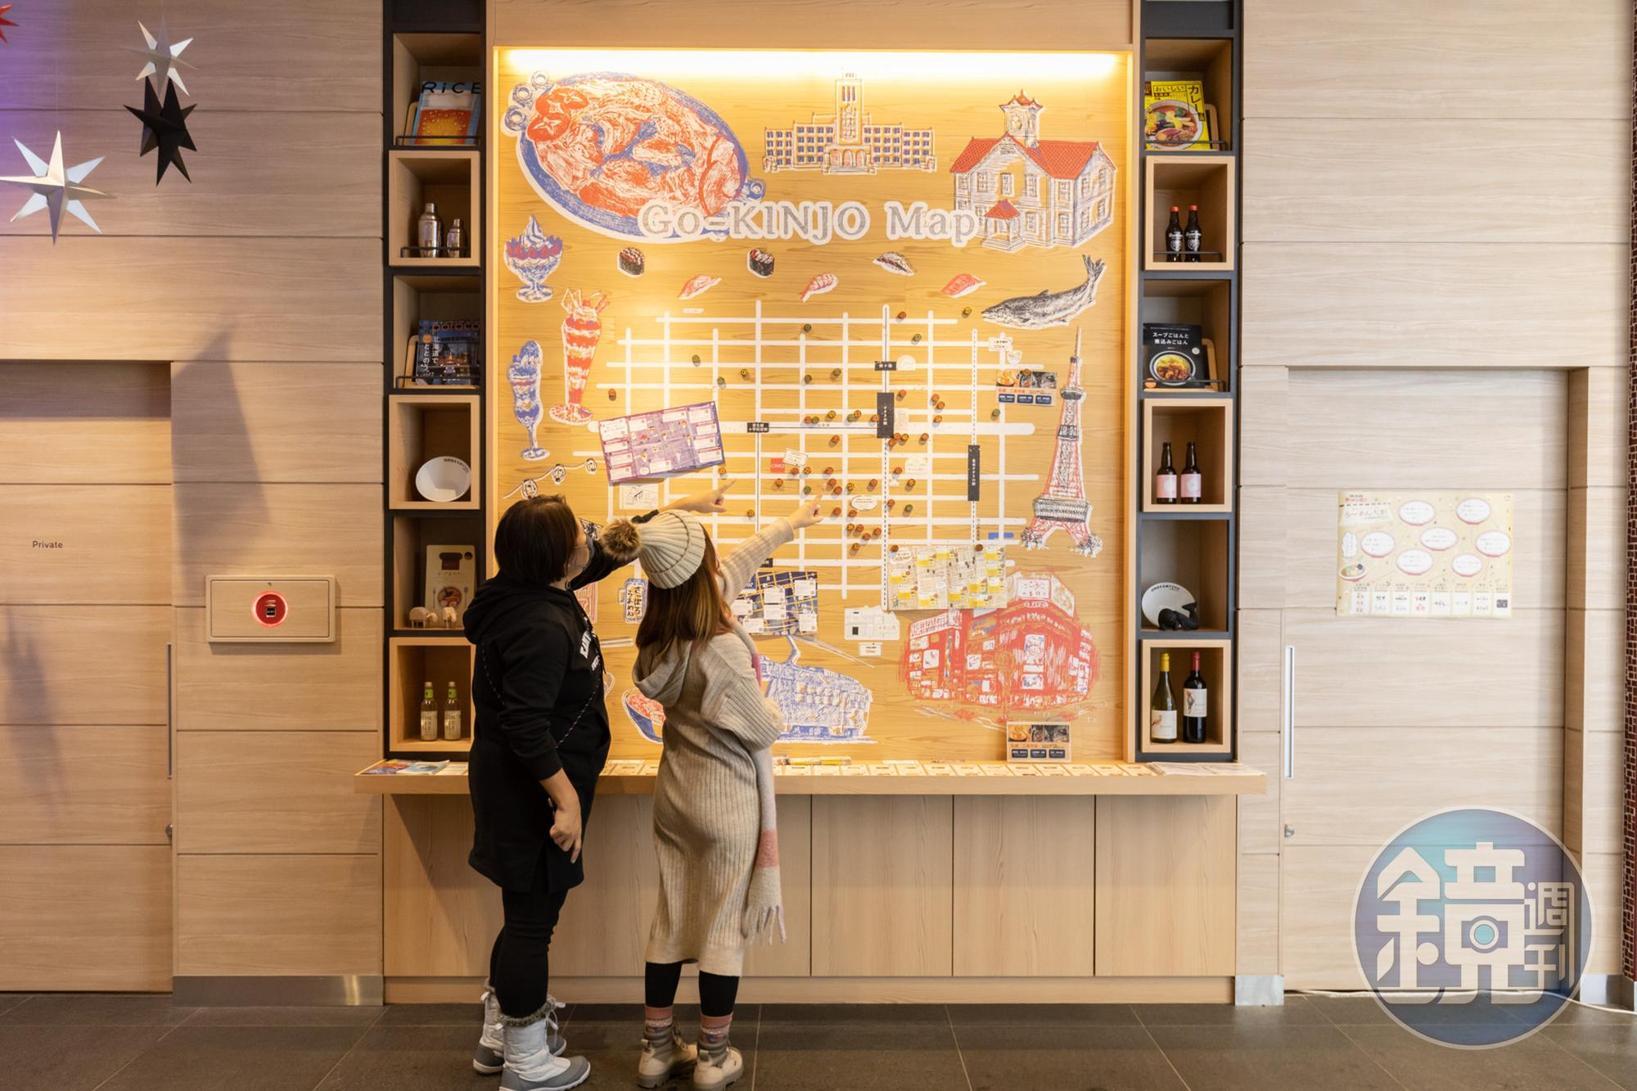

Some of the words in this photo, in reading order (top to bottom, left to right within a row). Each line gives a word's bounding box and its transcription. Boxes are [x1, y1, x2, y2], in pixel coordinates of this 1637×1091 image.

[639, 202, 869, 243] Go-KINJO
[887, 202, 978, 245] Map
[32, 540, 64, 549] Private
